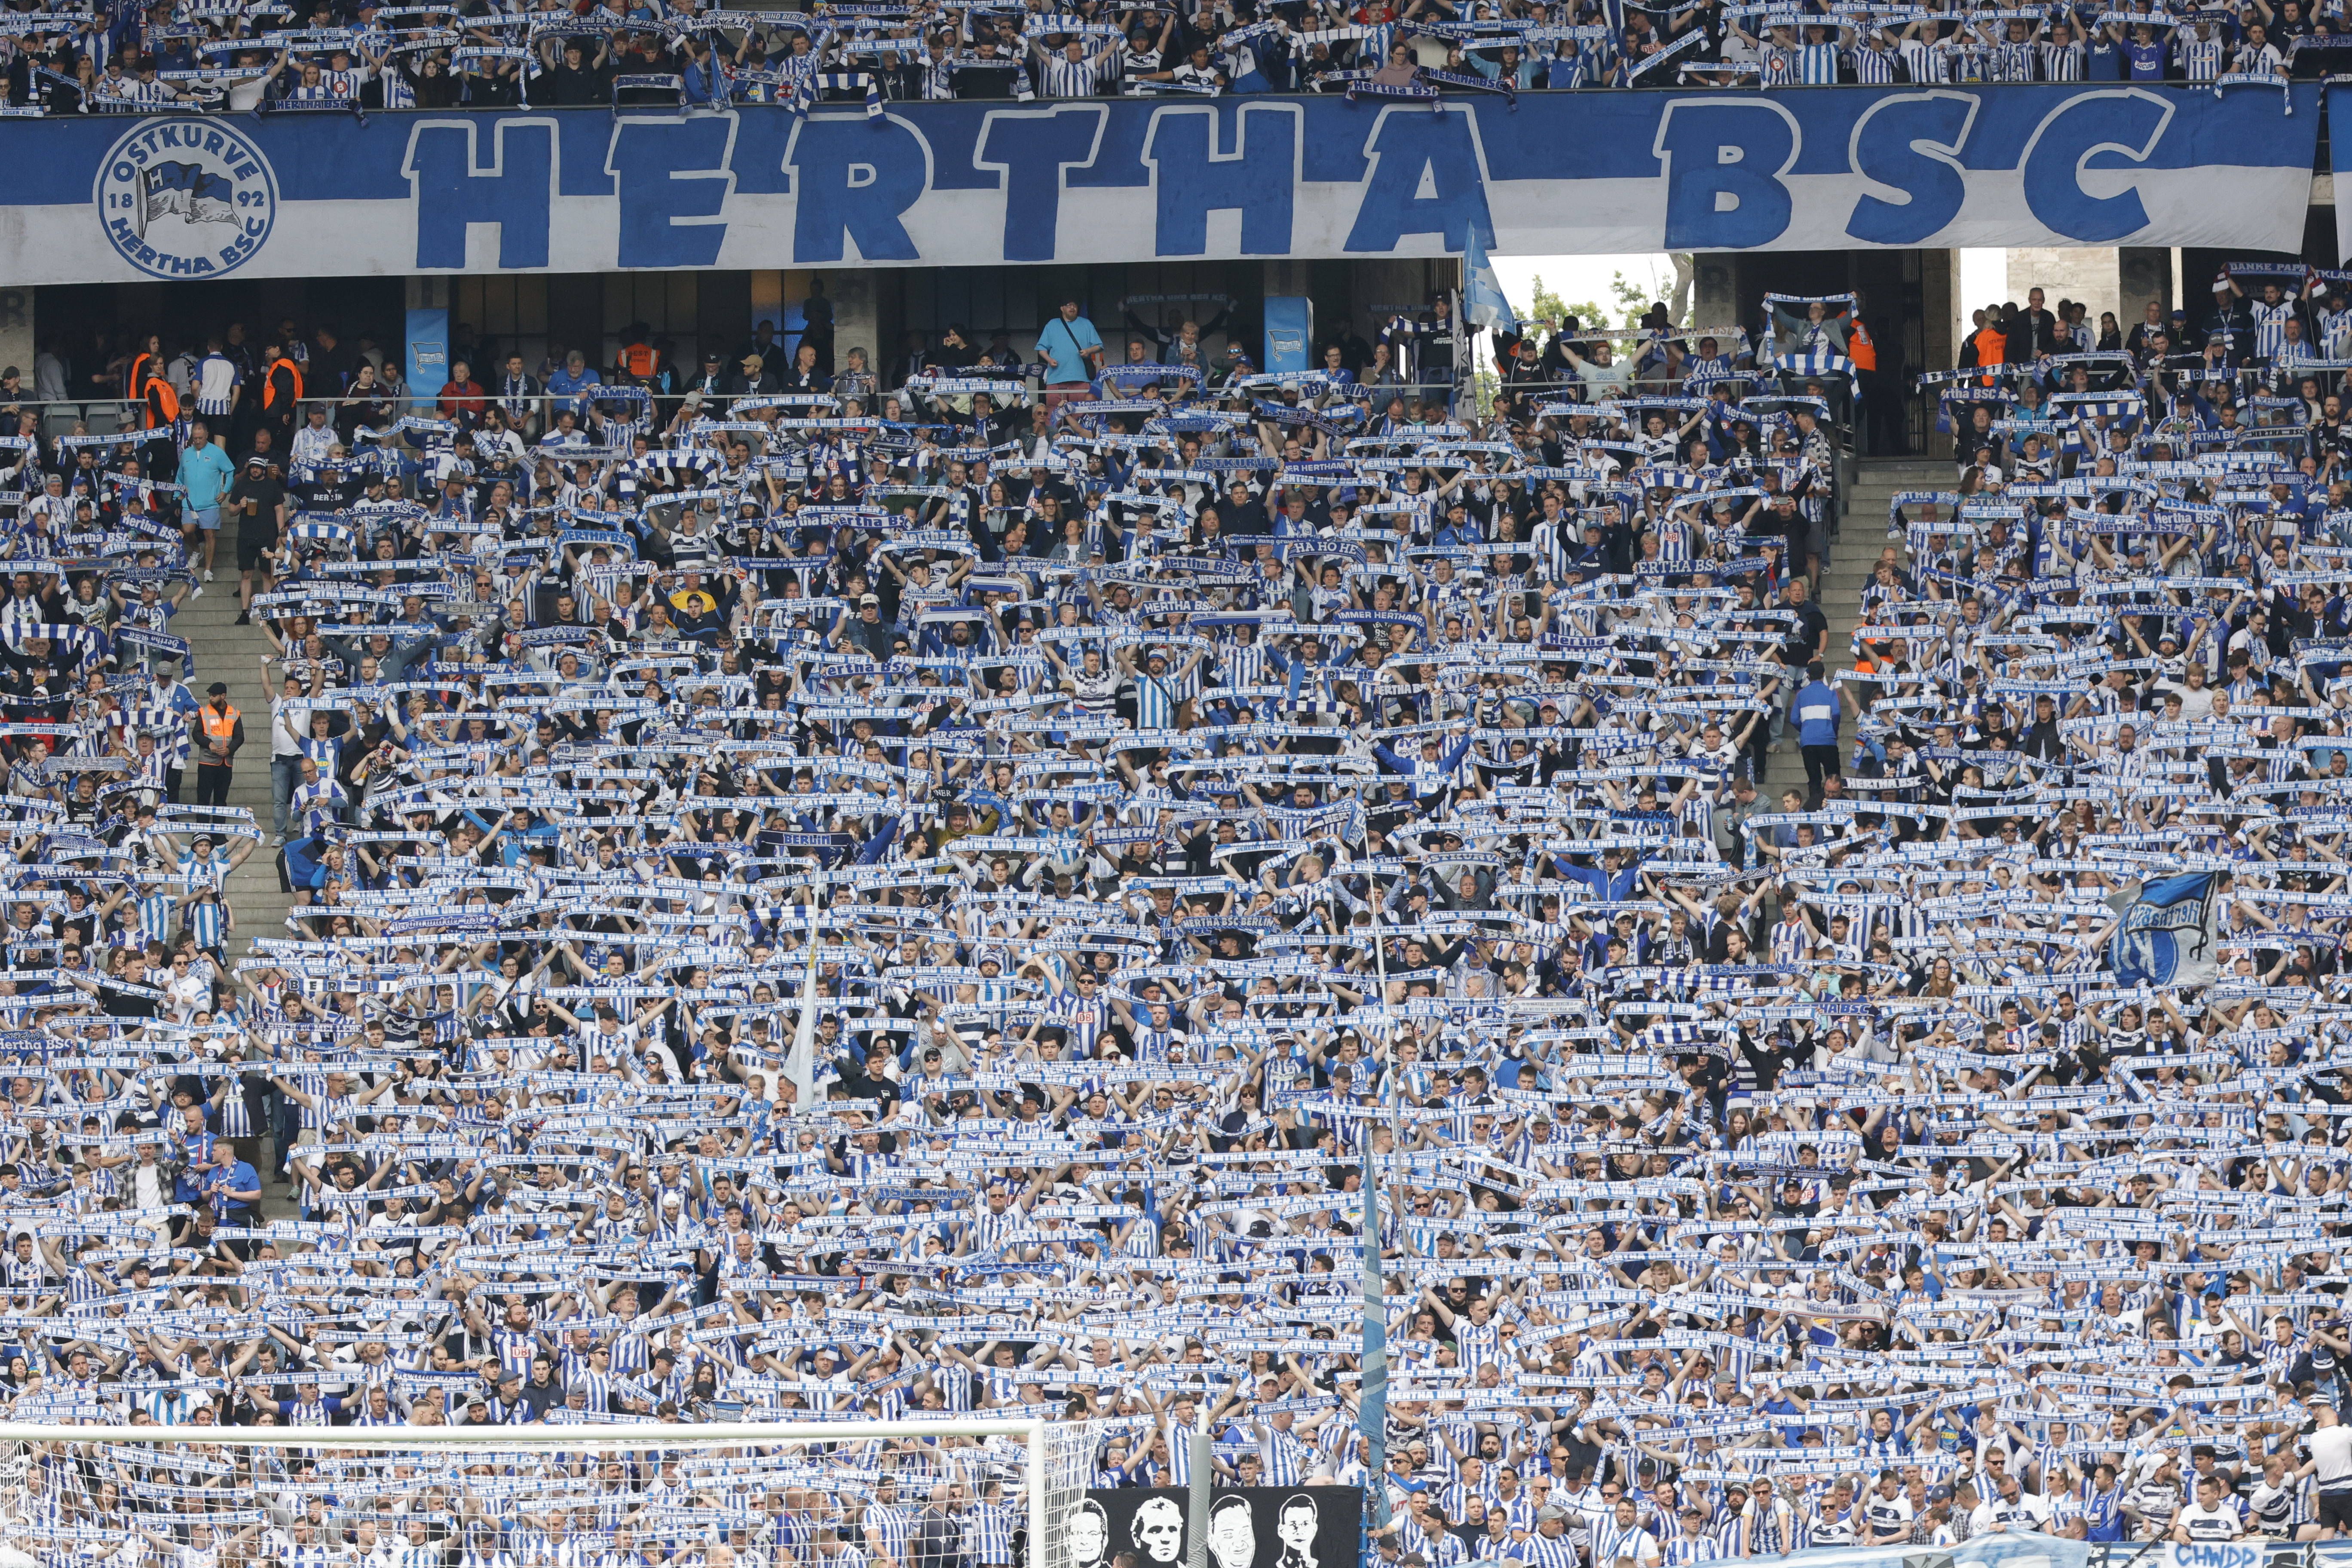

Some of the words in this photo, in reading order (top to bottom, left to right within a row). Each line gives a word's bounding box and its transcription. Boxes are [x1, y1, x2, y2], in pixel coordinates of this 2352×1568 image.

[34, 21, 64, 31] NICHT
[465, 17, 502, 26] HERTHA
[625, 19, 666, 29] HAUPTSTADT
[1525, 29, 1547, 40] NUR
[1548, 28, 1574, 39] NACH
[1575, 26, 1607, 37] HAUSE
[203, 42, 239, 52] HERTHA
[405, 39, 440, 49] HERTHA
[443, 37, 459, 45] BSC
[1430, 69, 1478, 84] HERTHA
[1480, 78, 1504, 90] BSC
[1355, 81, 1407, 94] Hertha
[276, 100, 322, 109] HERTHA
[323, 99, 349, 109] BSC
[113, 125, 259, 182] OSTKURVE
[402, 104, 1496, 269] HERTHA
[1655, 89, 2174, 250] BSC
[109, 193, 133, 208] 18
[237, 191, 264, 206] 92
[110, 217, 216, 274] HERTHA
[219, 216, 264, 265] BSC
[1194, 458, 1276, 469] OSTKURVE
[394, 505, 419, 515] BSC
[122, 515, 158, 534] Hertha
[64, 534, 103, 544] Hertha
[107, 533, 129, 542] BSC
[1296, 543, 1315, 552] HA
[1340, 544, 1357, 554] HE
[431, 604, 499, 613] Berlin
[1375, 612, 1424, 626] HERTHANER
[434, 663, 459, 673] BSC
[463, 663, 506, 674] Hertha
[1643, 837, 1664, 845] KSC
[392, 919, 423, 931] Hertha
[446, 917, 460, 925] der
[1078, 1014, 1092, 1022] DB
[2138, 1211, 2156, 1221] KSC
[1541, 1292, 1584, 1302] HERTHA
[693, 1329, 738, 1340] HERTHA
[1517, 1330, 1560, 1346] HERTHA
[1563, 1322, 1584, 1333] UND
[1590, 1313, 1611, 1324] DER
[1642, 1431, 1686, 1439] HERTHA
[2176, 1545, 2256, 1568] CHWDP
